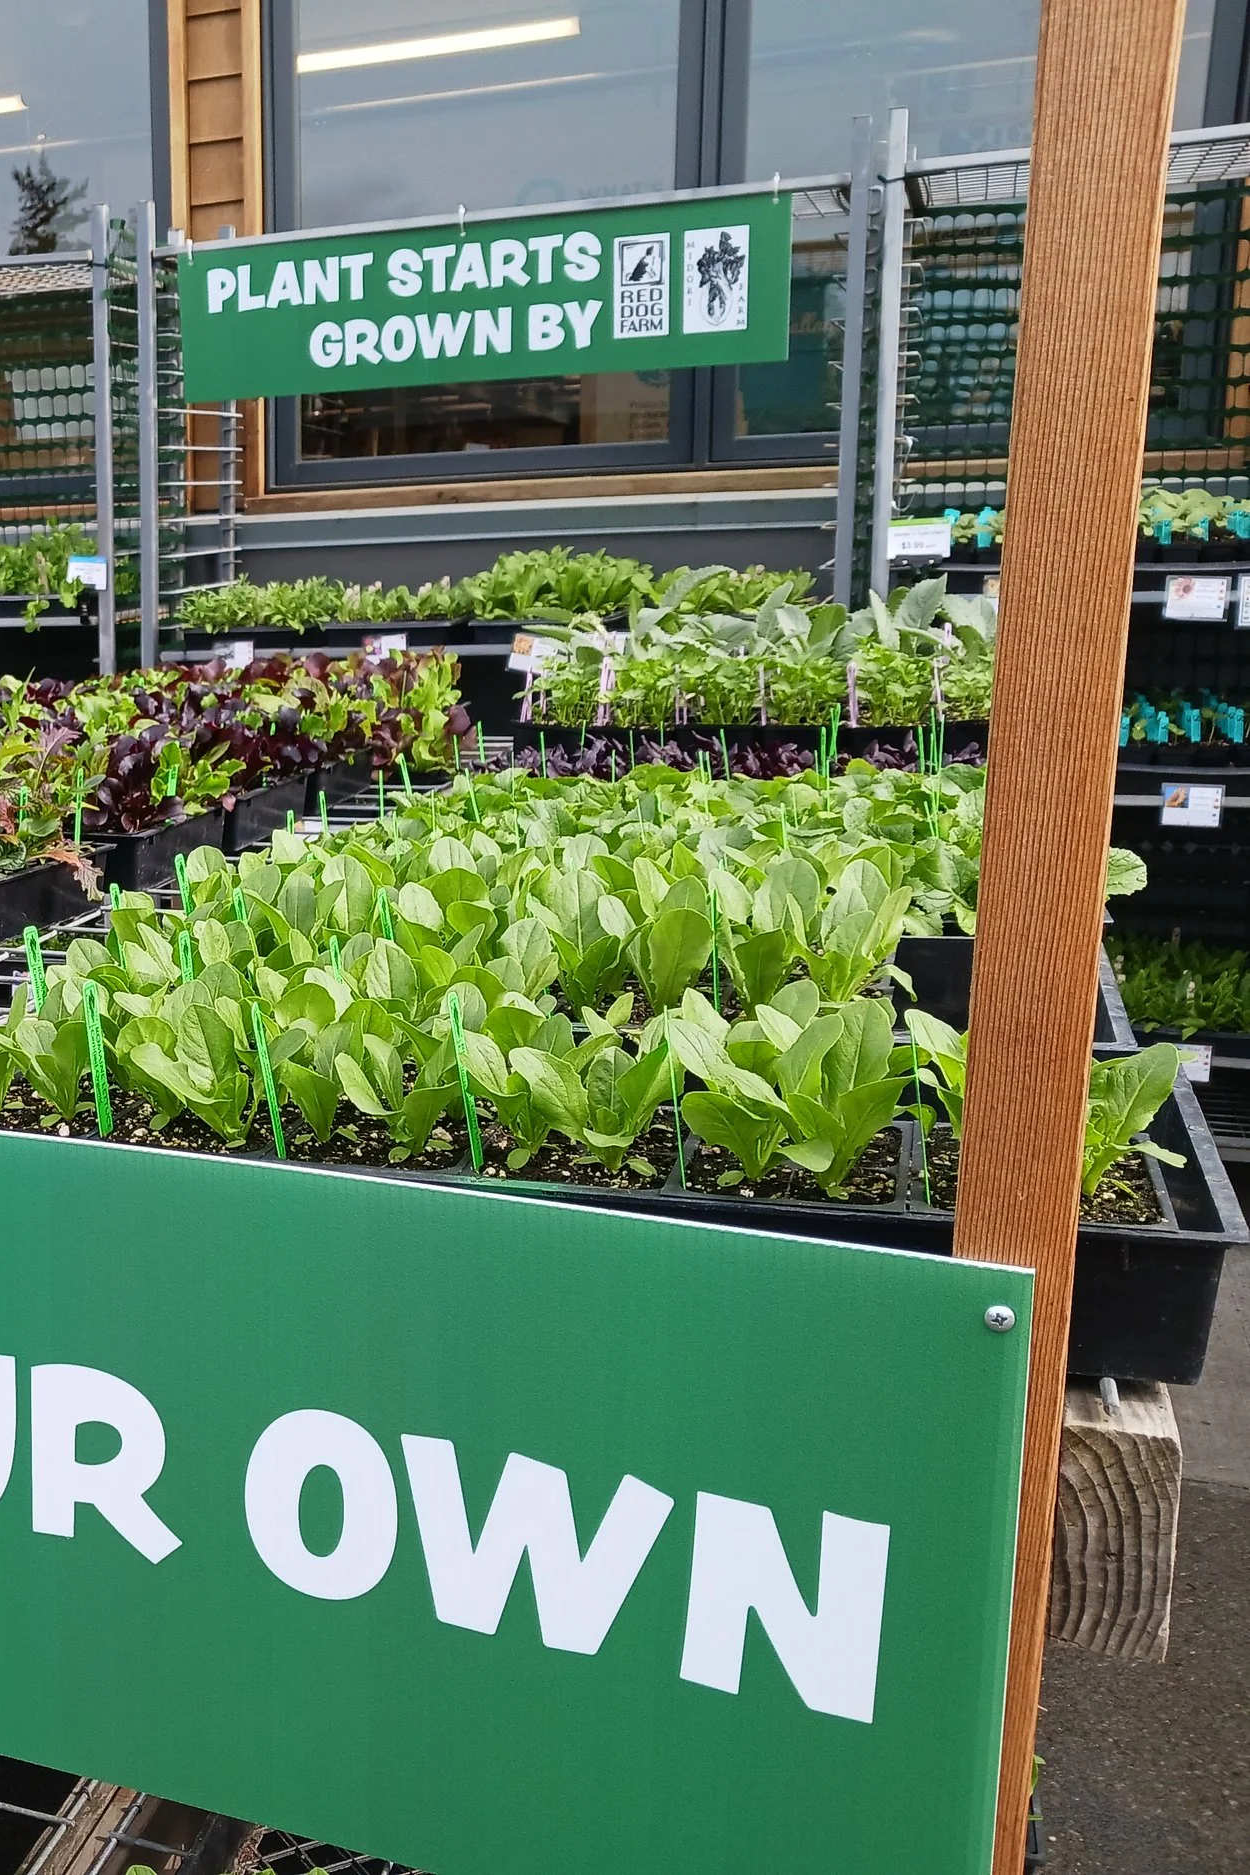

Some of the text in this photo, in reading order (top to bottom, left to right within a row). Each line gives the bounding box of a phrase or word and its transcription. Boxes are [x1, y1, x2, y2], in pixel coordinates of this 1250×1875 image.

[208, 232, 601, 313] PLANT STARTS
[620, 288, 663, 303] RED
[686, 242, 694, 306] MIDORI
[737, 283, 745, 325] FARM
[310, 300, 602, 367] GROWN BY
[620, 303, 663, 318] DOG
[620, 318, 663, 333] FARM
[95, 1026, 111, 1129] ROMAINE LETTUCE
[245, 1409, 890, 1723] OWN
